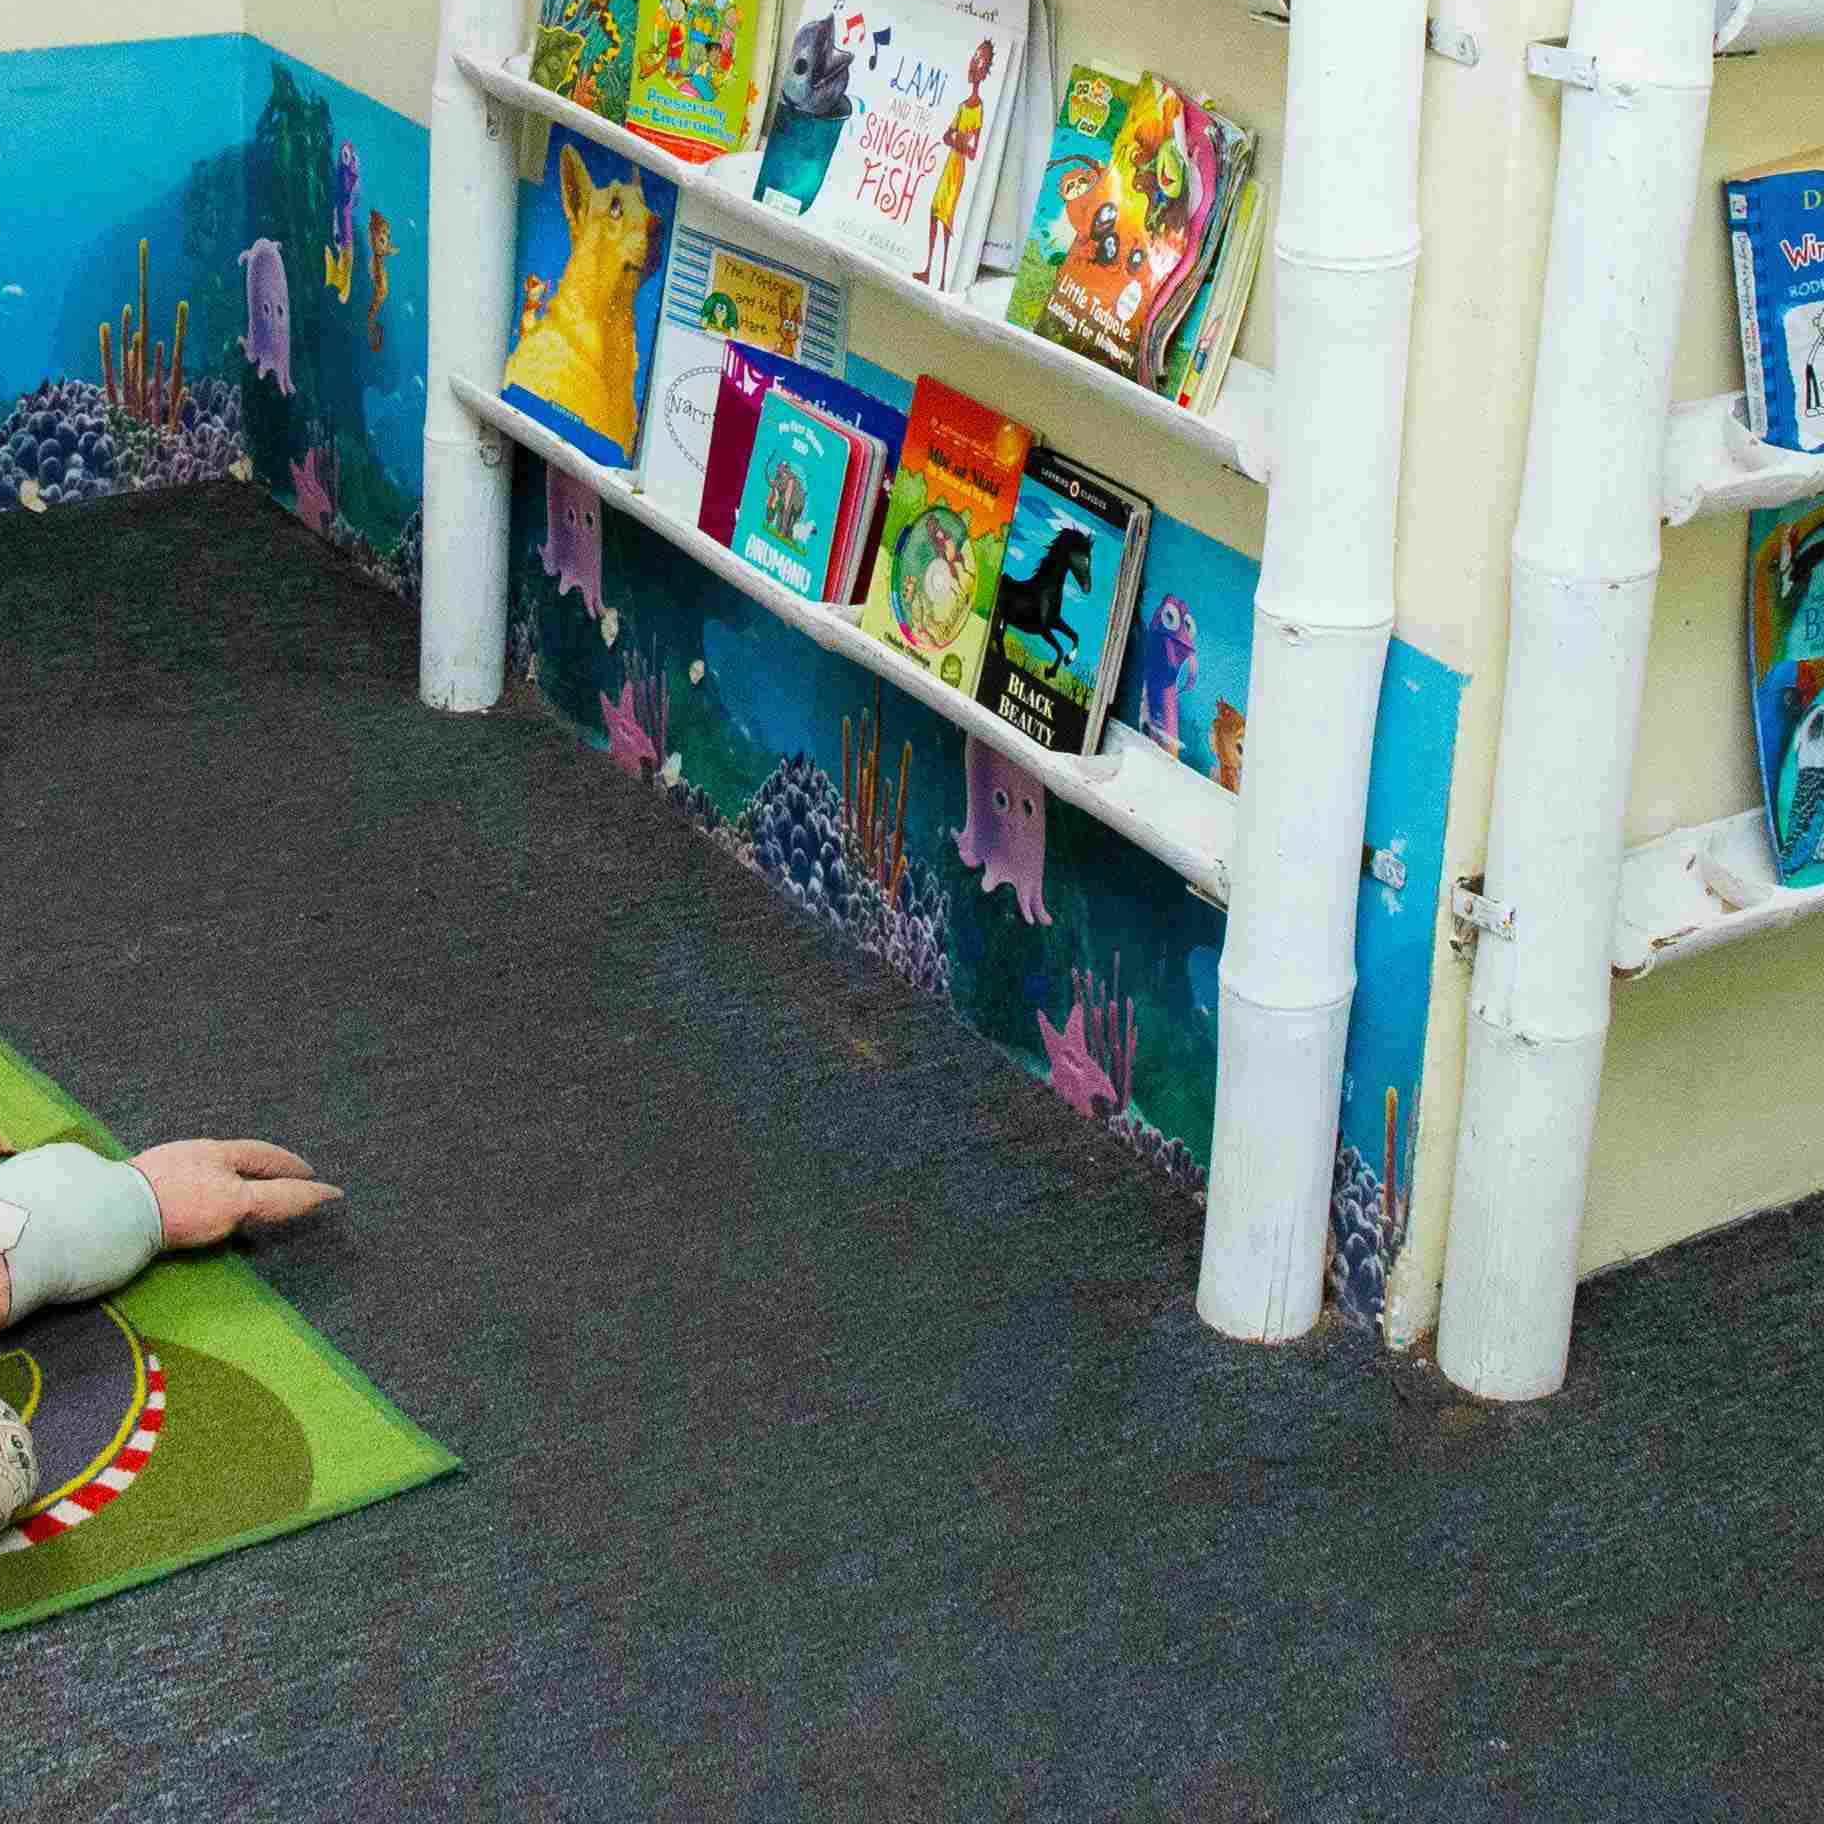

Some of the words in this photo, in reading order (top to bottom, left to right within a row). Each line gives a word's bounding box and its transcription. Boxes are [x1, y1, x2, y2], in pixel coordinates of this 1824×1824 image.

[1059, 276, 1089, 309] Little
[669, 391, 716, 427] Narr
[1007, 672, 1055, 720] BLACK
[998, 695, 1055, 748] BEAUTY
